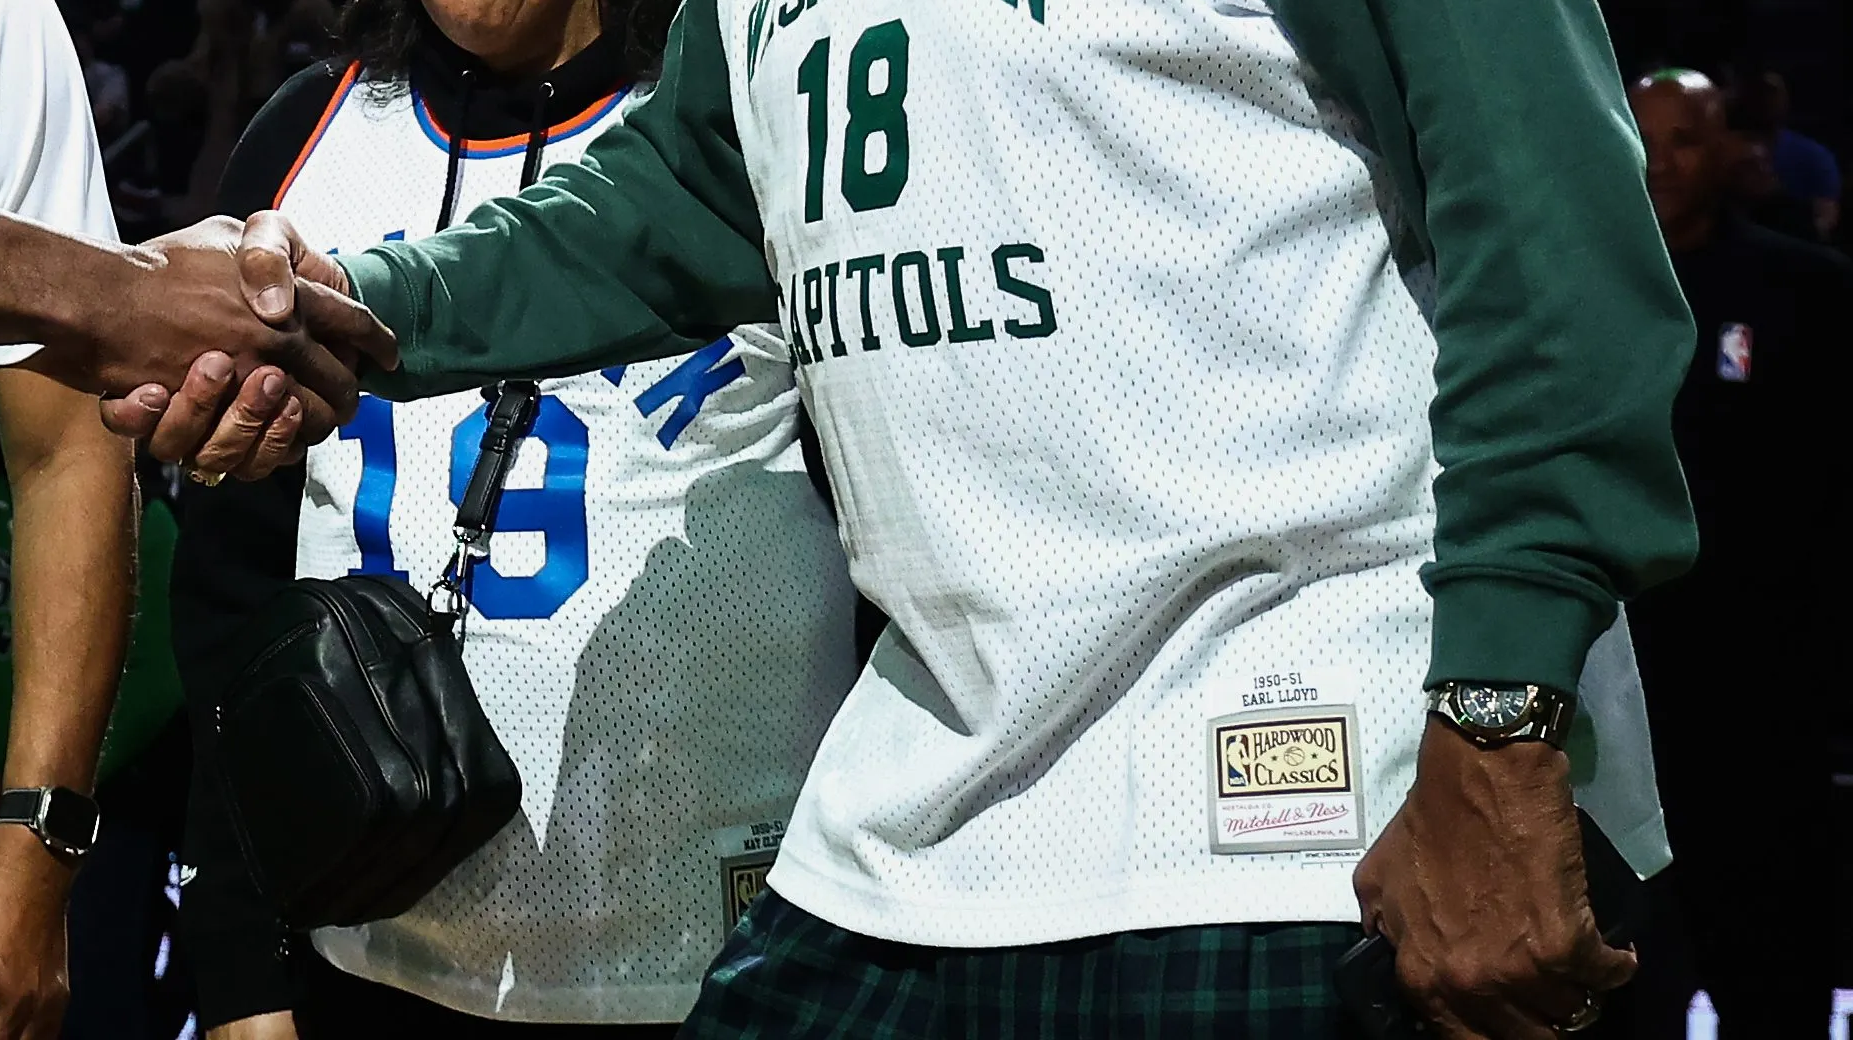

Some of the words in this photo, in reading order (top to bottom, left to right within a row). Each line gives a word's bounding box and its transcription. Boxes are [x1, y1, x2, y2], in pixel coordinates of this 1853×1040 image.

[797, 18, 910, 224] 18
[779, 243, 1058, 369] APITOLS
[337, 394, 589, 620] 19
[1253, 672, 1303, 690] 1950-51
[1242, 693, 1274, 707] EARL
[1279, 688, 1318, 702] LLOYD
[1252, 728, 1336, 760] HARDWOOD
[1254, 759, 1339, 786] CLASSICS
